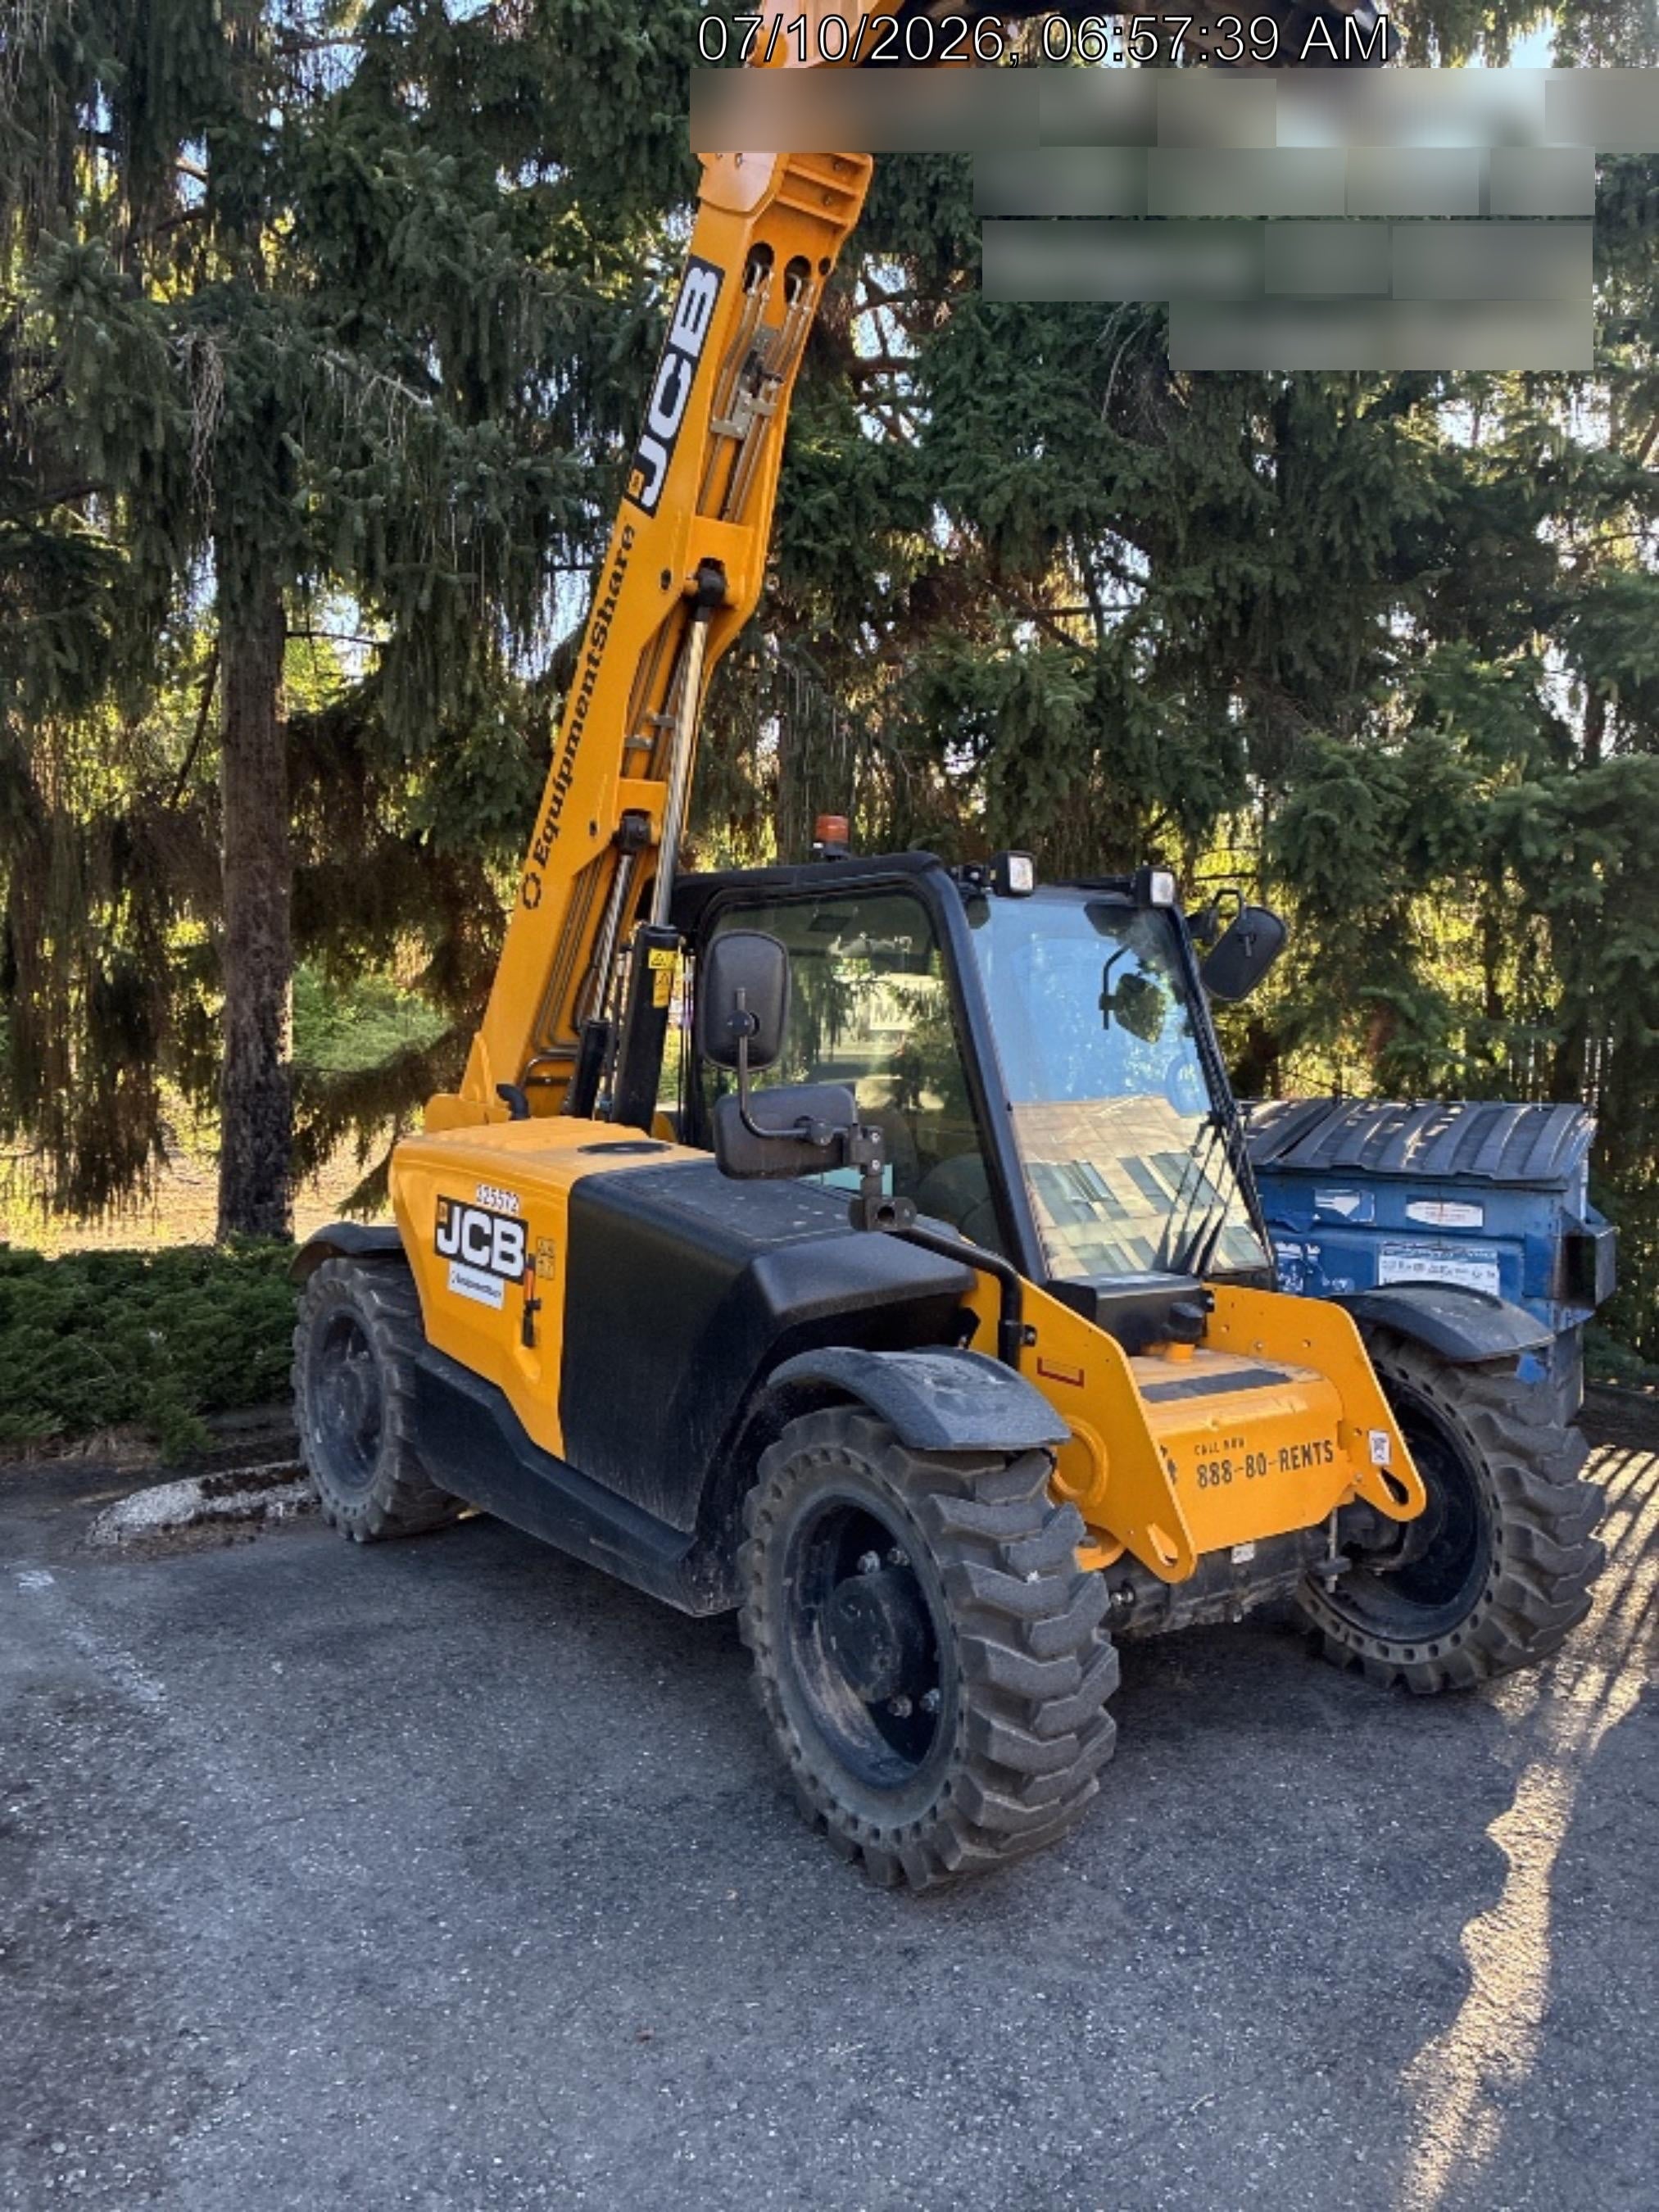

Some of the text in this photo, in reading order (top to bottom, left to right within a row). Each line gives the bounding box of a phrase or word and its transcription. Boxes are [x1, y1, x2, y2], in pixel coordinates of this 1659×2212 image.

[639, 266, 718, 508] JCB
[533, 523, 635, 870] EquipmentShare
[437, 1205, 525, 1277] JCB
[1196, 1439, 1334, 1489] 888-80-RENTS
